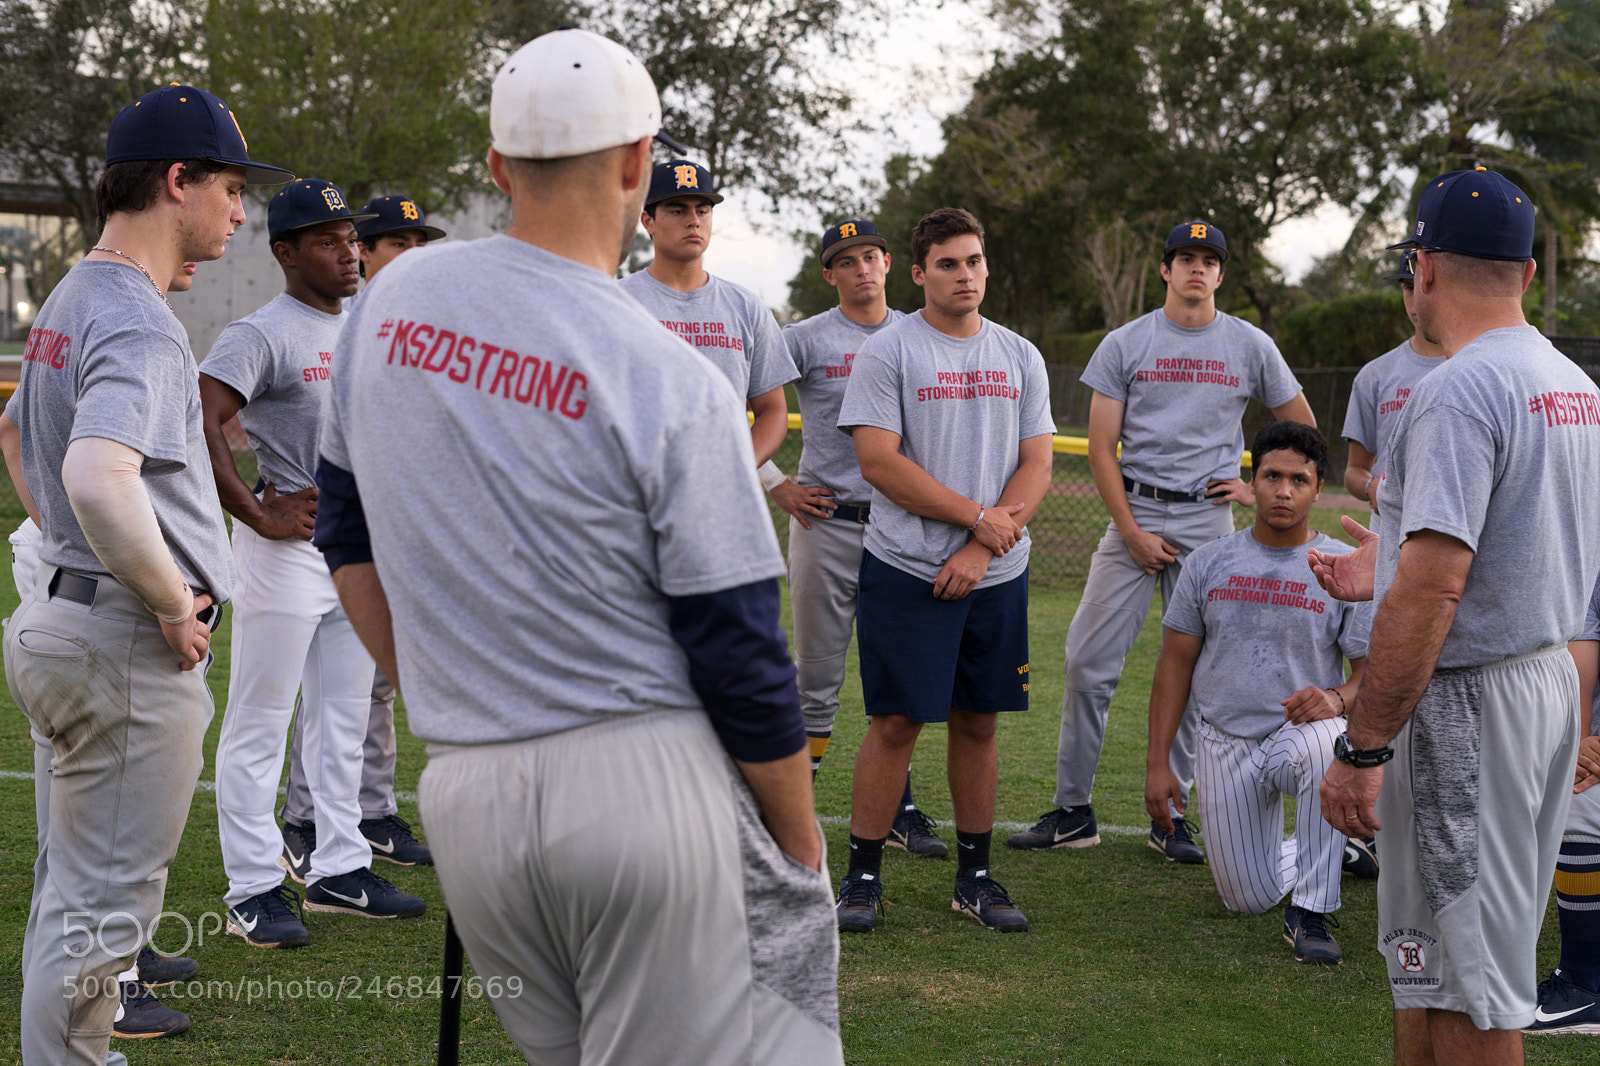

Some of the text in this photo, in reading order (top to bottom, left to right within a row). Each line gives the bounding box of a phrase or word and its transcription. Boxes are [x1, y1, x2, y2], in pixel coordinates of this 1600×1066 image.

[658, 320, 725, 334] AYING FOR
[695, 335, 743, 352] DOUGLAS
[376, 319, 589, 421] #MSDSTRONG
[1155, 357, 1226, 373] PRAYING FOR
[937, 371, 1008, 386] PRAYING FOR
[1136, 369, 1241, 388] STONEMAN DOUGLAS
[917, 386, 977, 402] STONEMAN
[1227, 576, 1308, 596] PRAYING FOR
[1208, 588, 1326, 614] STONEMAN DOUGLAS
[1408, 928, 1437, 946] JESUIT
[1391, 977, 1440, 986] WOLVERINES
